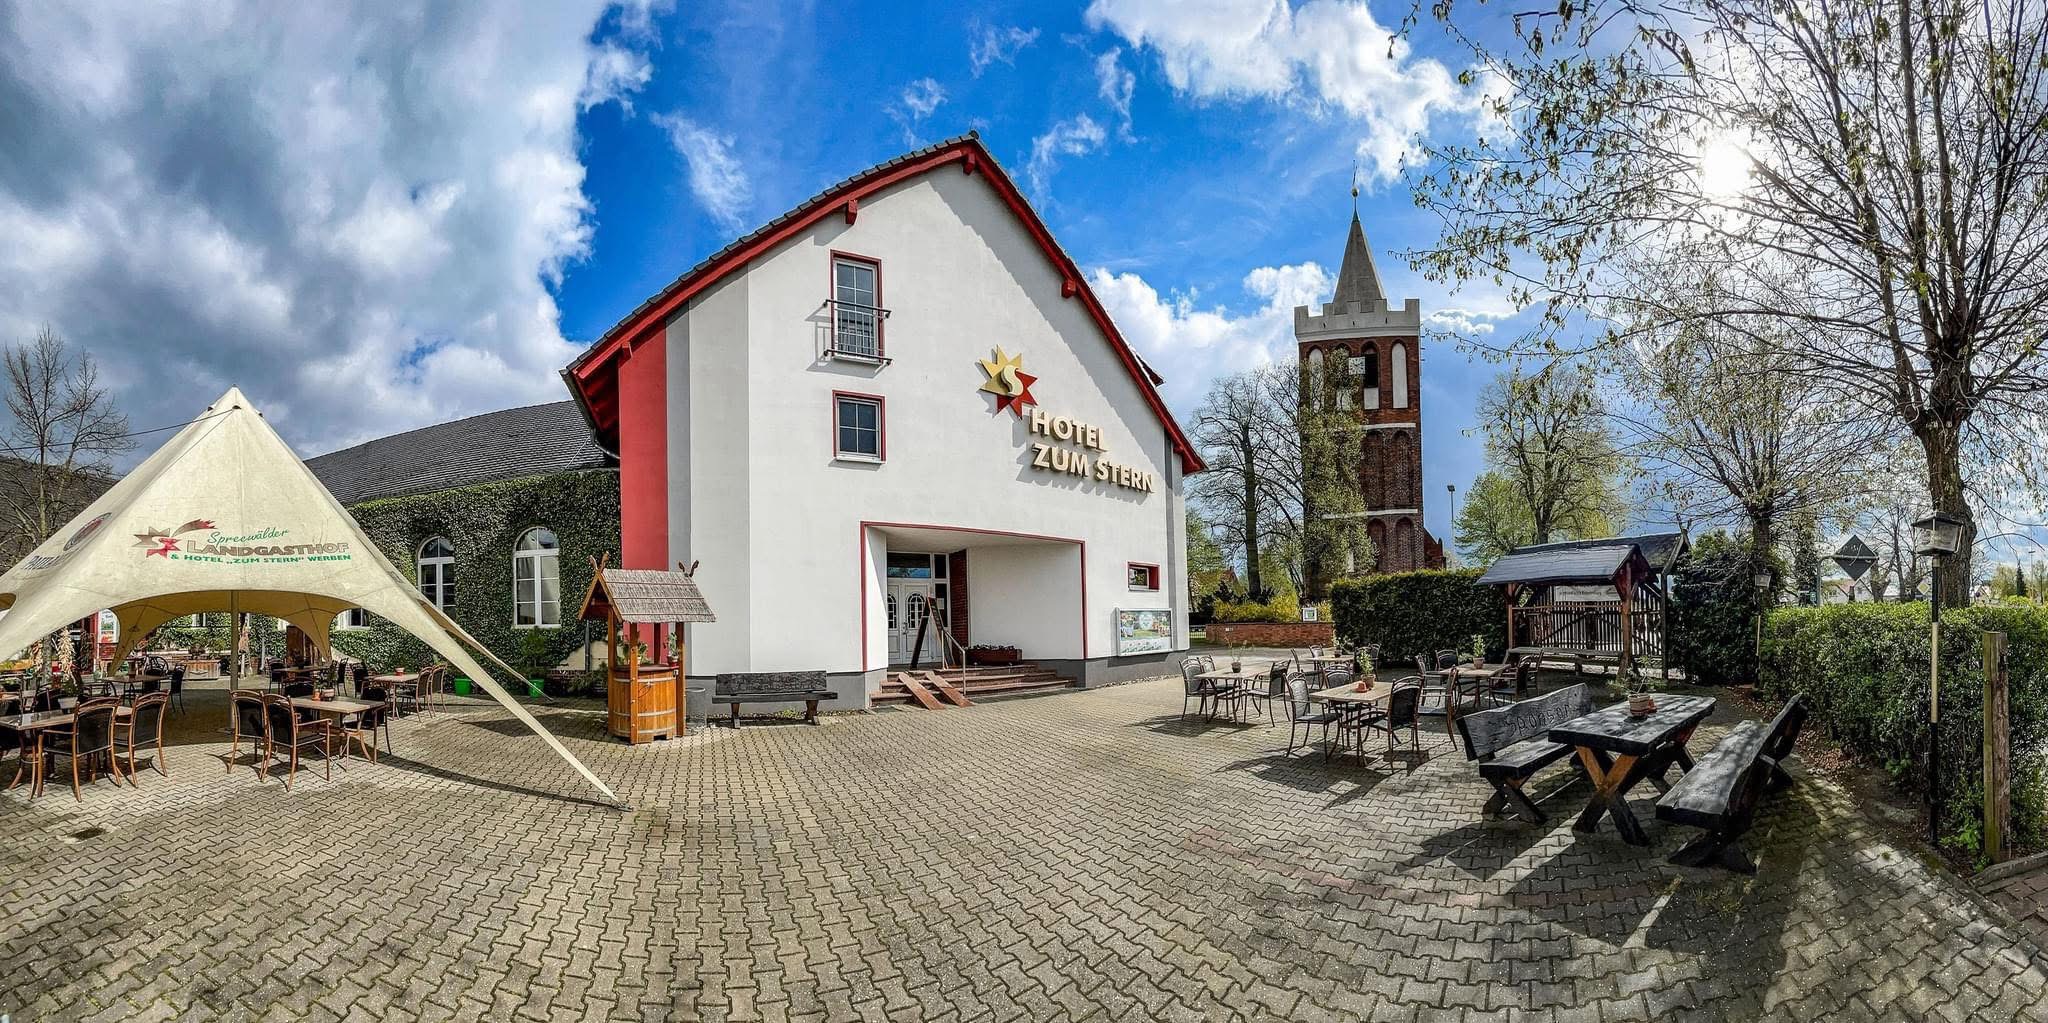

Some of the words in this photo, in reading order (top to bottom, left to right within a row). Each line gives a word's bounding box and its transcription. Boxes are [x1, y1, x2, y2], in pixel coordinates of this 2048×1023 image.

[1030, 408, 1108, 452] HOTEL
[1032, 443, 1089, 477] ZUM
[1094, 456, 1155, 493] STERN
[207, 527, 288, 547] Spreewälder
[184, 554, 223, 562] HOTEL
[307, 554, 351, 562] WERBEN
[187, 540, 349, 556] LANDGASTHOF
